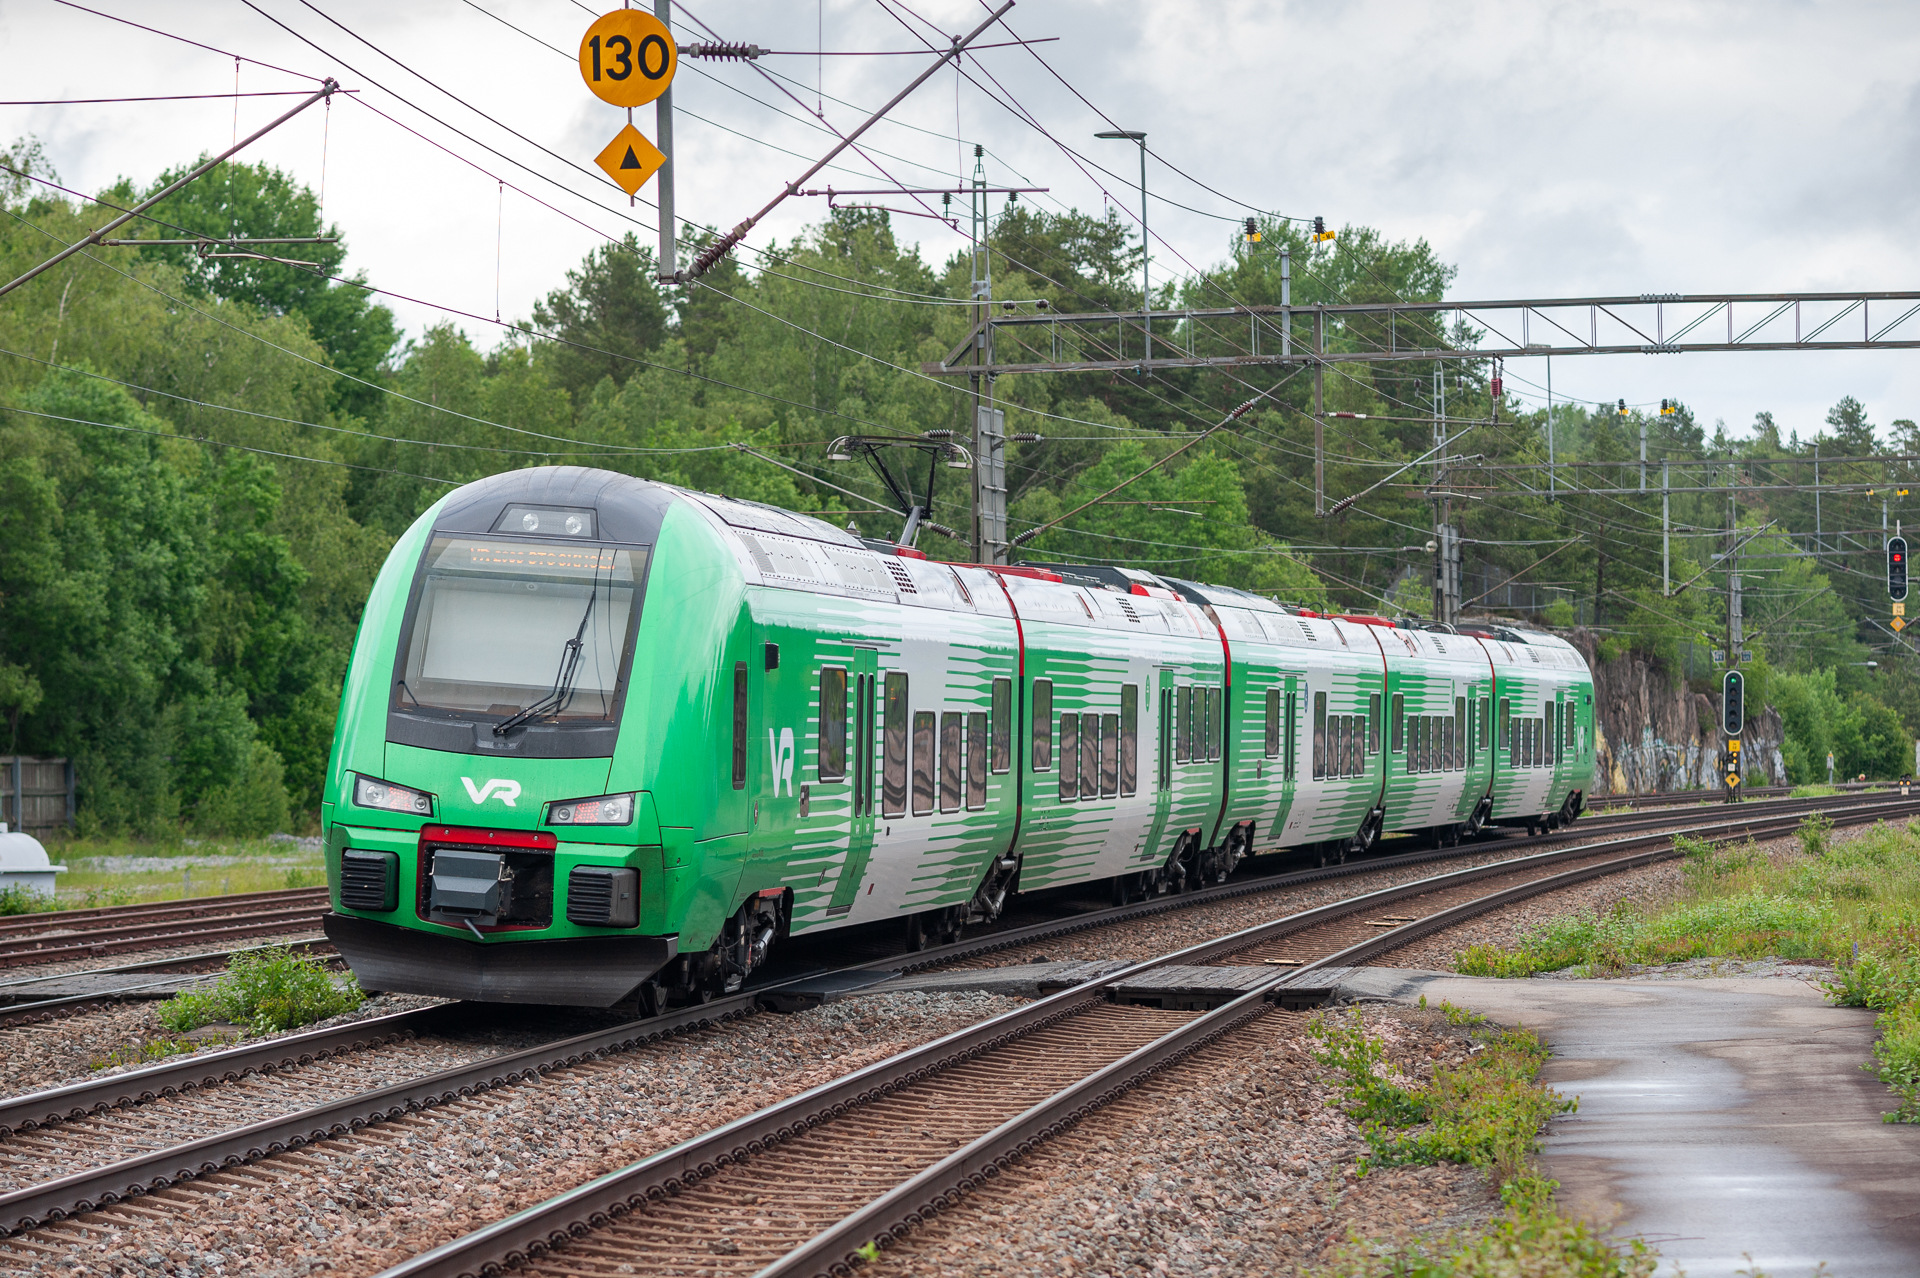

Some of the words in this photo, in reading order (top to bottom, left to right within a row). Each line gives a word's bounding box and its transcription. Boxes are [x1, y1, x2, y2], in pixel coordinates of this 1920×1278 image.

[589, 34, 670, 81] 130
[768, 728, 794, 798] VR
[460, 776, 521, 807] VR
